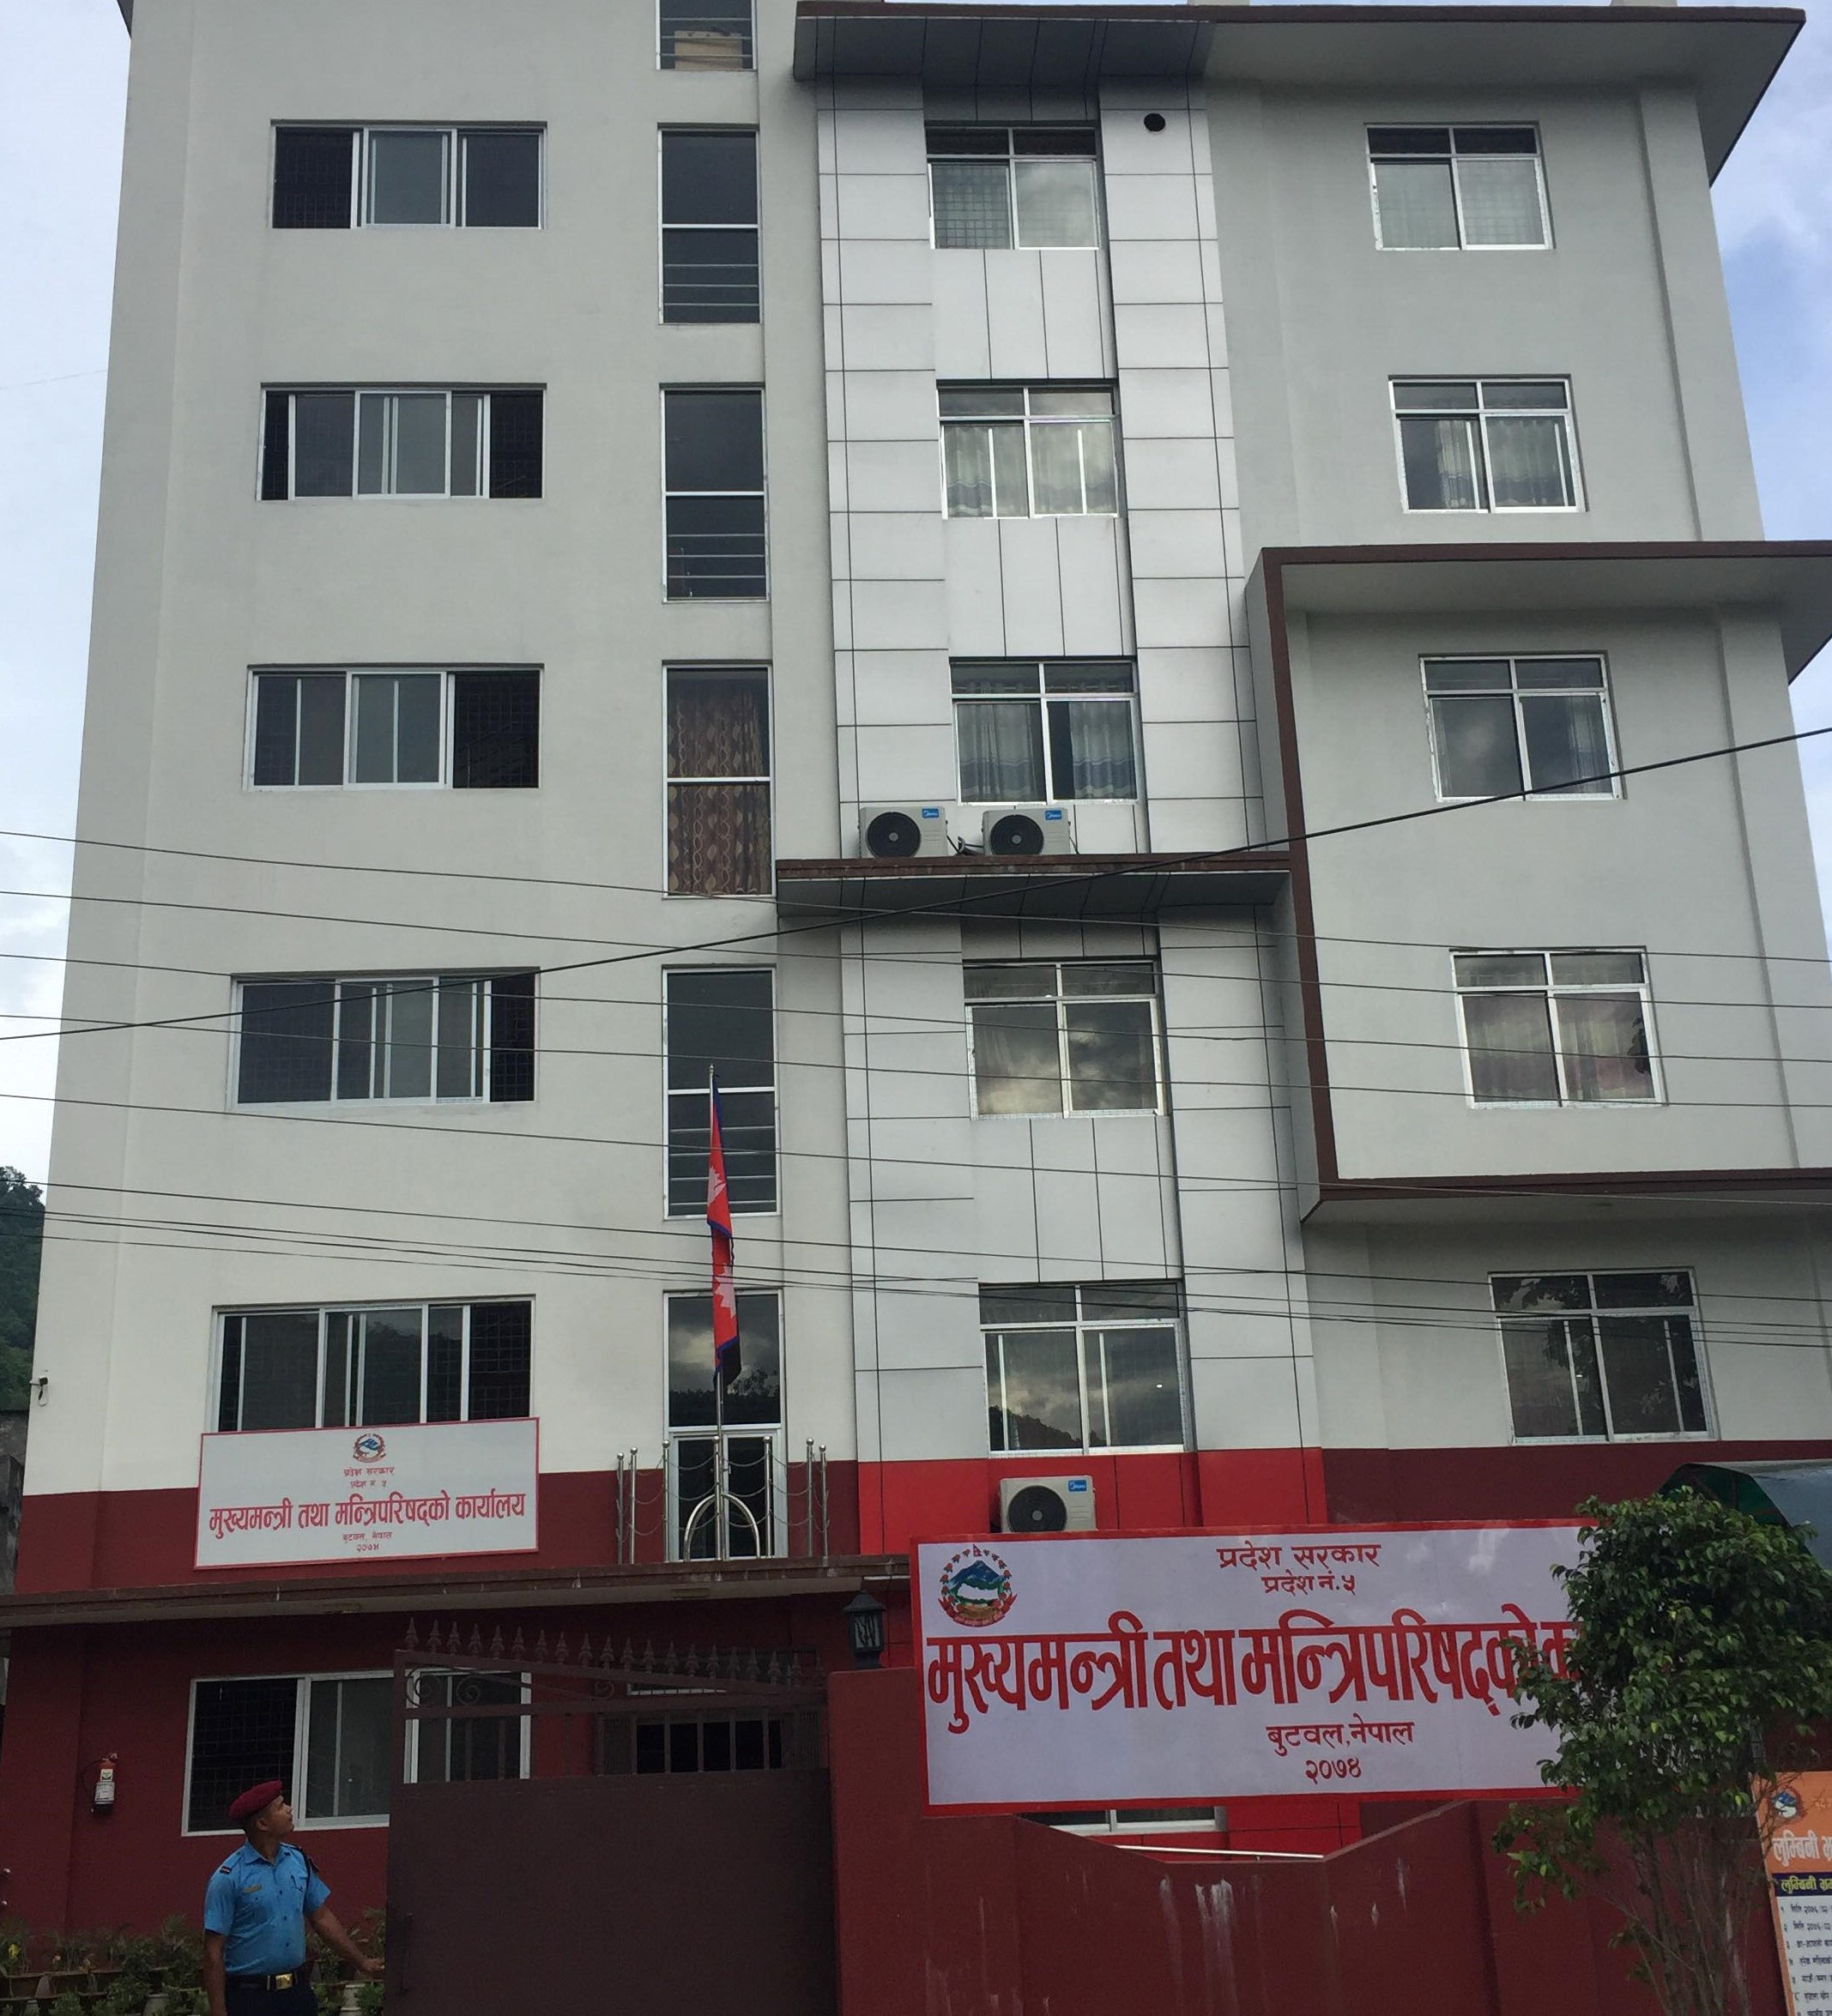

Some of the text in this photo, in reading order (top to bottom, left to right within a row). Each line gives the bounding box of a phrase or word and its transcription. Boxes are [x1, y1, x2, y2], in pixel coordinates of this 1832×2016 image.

[366, 1466, 395, 1476] सरकार
[209, 1488, 526, 1539] मुख्यमन्त्री तथा मन्त्रिपरिषद्को कार्यालय
[1216, 1540, 1382, 1570] प्रदेश सरकार
[1261, 1569, 1314, 1597] प्रदेश
[926, 1609, 1148, 1734] मुख्यमन्त्री
[1153, 1628, 1236, 1711] तथा
[1304, 1758, 1363, 1784] २०७४
